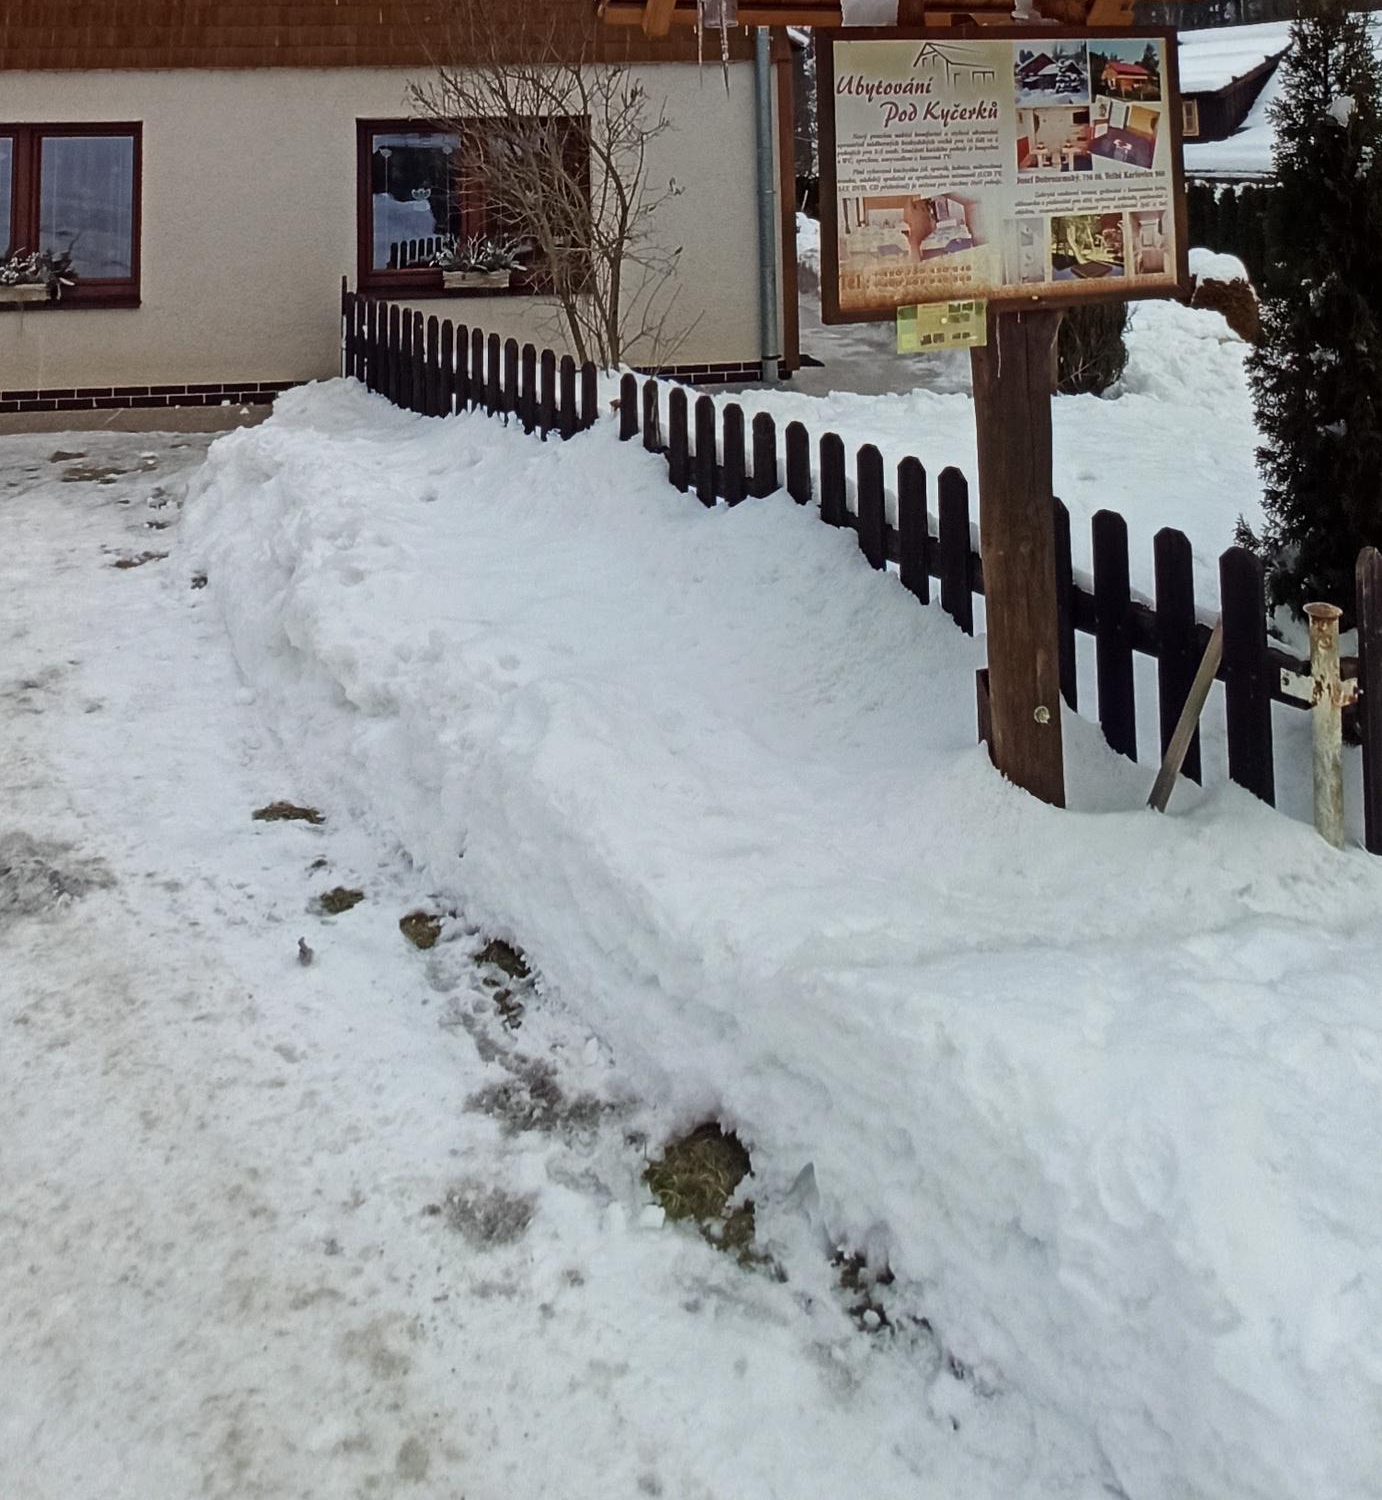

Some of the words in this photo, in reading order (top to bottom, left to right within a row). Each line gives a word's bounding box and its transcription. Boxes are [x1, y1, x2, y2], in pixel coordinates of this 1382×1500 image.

[836, 75, 933, 103] Ubytování
[880, 101, 918, 128] Pod
[923, 100, 998, 127] Kyčerků
